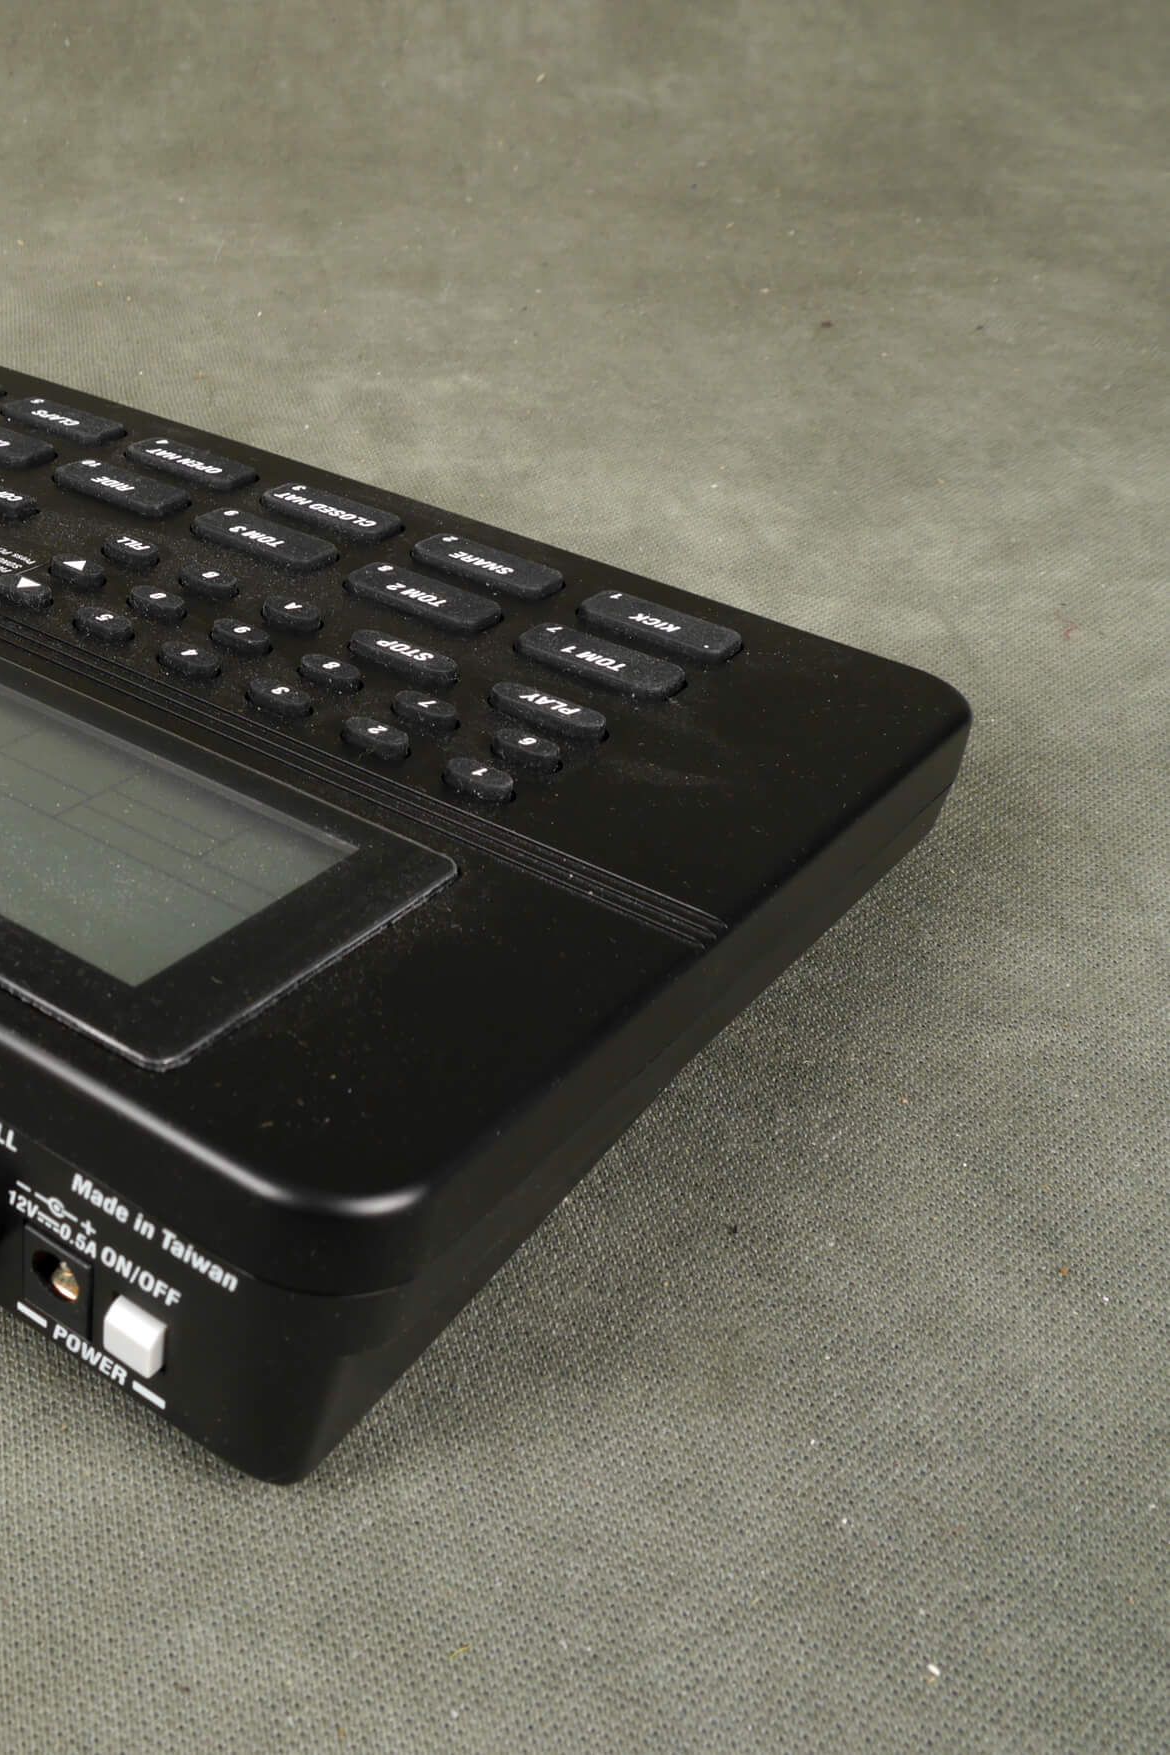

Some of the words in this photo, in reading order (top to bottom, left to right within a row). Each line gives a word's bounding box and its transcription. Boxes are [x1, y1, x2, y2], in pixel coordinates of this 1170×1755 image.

[30, 409, 81, 427] CLAPS
[144, 447, 183, 461] HAT
[175, 457, 223, 475] OPEN
[89, 475, 136, 492] RIDE
[291, 484, 307, 492] 3
[273, 491, 314, 506] HAT
[223, 509, 240, 517] 9
[309, 503, 377, 527] CLOSED
[228, 525, 248, 534] 3
[116, 535, 151, 551] FILL
[240, 528, 285, 548] TOM
[441, 535, 459, 543] 2
[11, 552, 37, 566] Press
[447, 550, 515, 575] SNARE
[376, 564, 394, 573] 8
[385, 581, 407, 592] 2
[399, 587, 448, 608] TOM
[609, 592, 623, 600] 1
[283, 601, 303, 611] A
[94, 613, 115, 622] 5
[627, 612, 682, 633] KICK
[233, 625, 252, 634] 9
[545, 626, 564, 634] 7
[180, 648, 199, 657] 4
[375, 639, 435, 662] STOP
[559, 645, 577, 654] 1
[321, 661, 342, 670] 8
[574, 650, 627, 673] TOM
[270, 686, 291, 696] 3
[417, 699, 438, 709] 7
[518, 692, 582, 716] PLAY
[367, 724, 389, 735] 2
[517, 736, 538, 746] 6
[471, 767, 489, 777] 1
[71, 1173, 130, 1223] Made
[133, 1211, 156, 1240] in
[161, 1227, 240, 1293] Taiwan
[100, 1245, 181, 1308] ON/OFF
[51, 1323, 128, 1386] POWER
